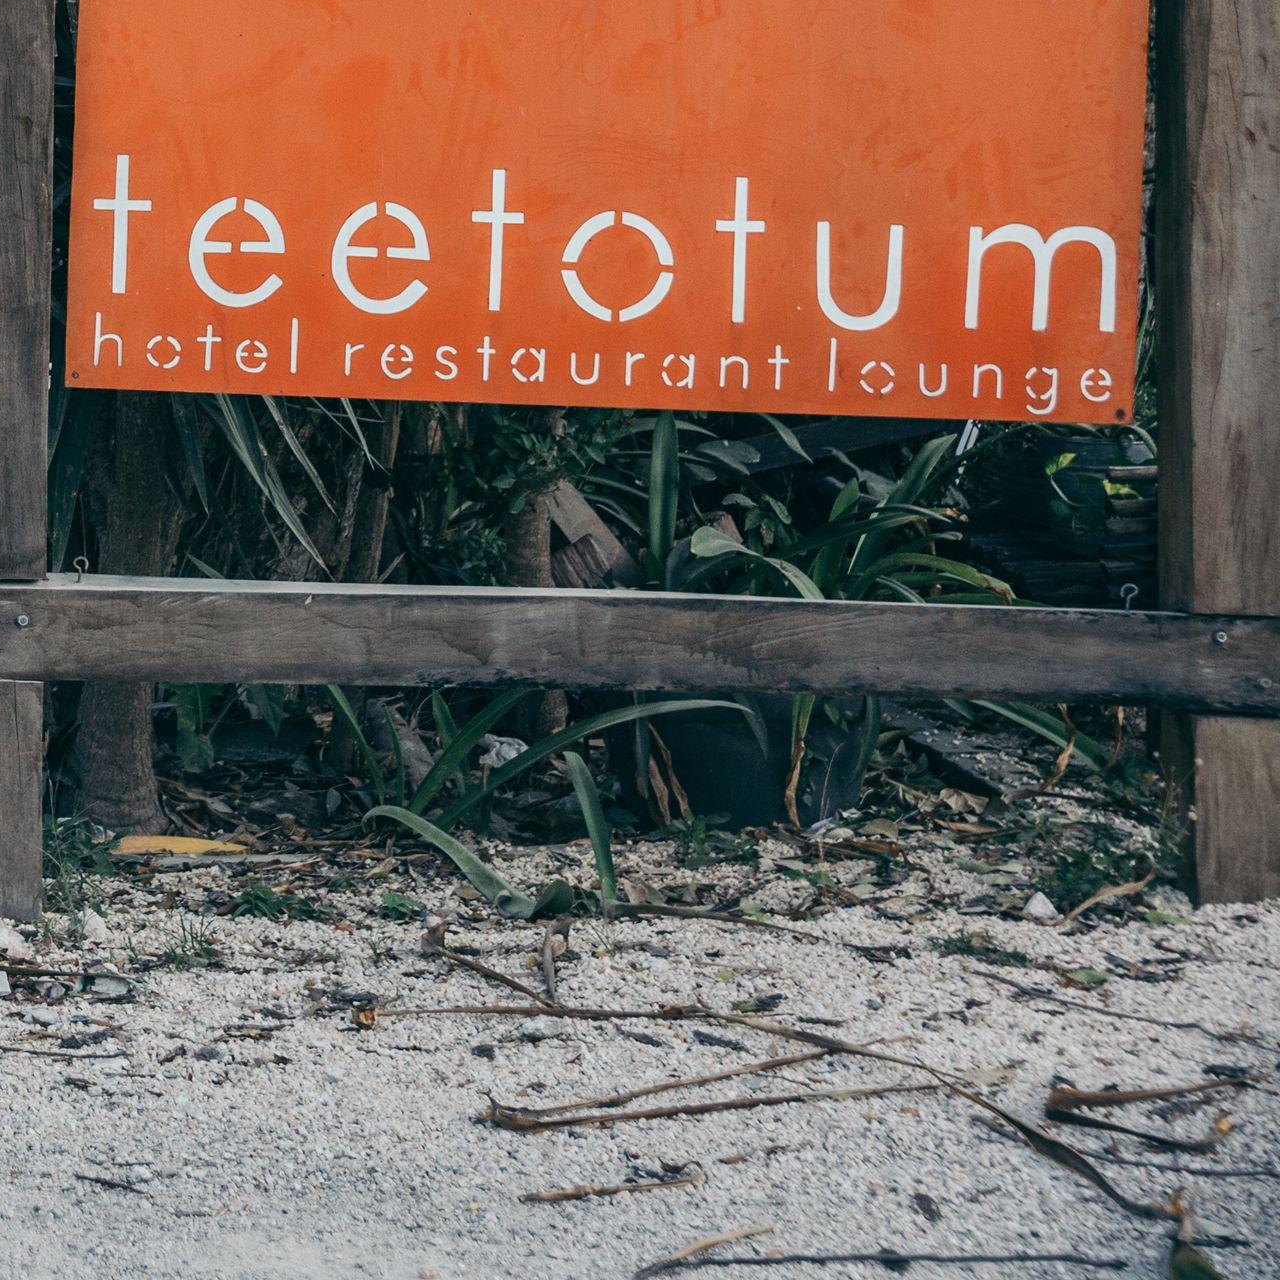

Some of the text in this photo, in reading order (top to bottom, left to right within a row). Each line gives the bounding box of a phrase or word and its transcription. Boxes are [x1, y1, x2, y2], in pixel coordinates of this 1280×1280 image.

[93, 154, 1116, 332] teetotum
[93, 311, 1113, 415] hotel restaurant lounge
